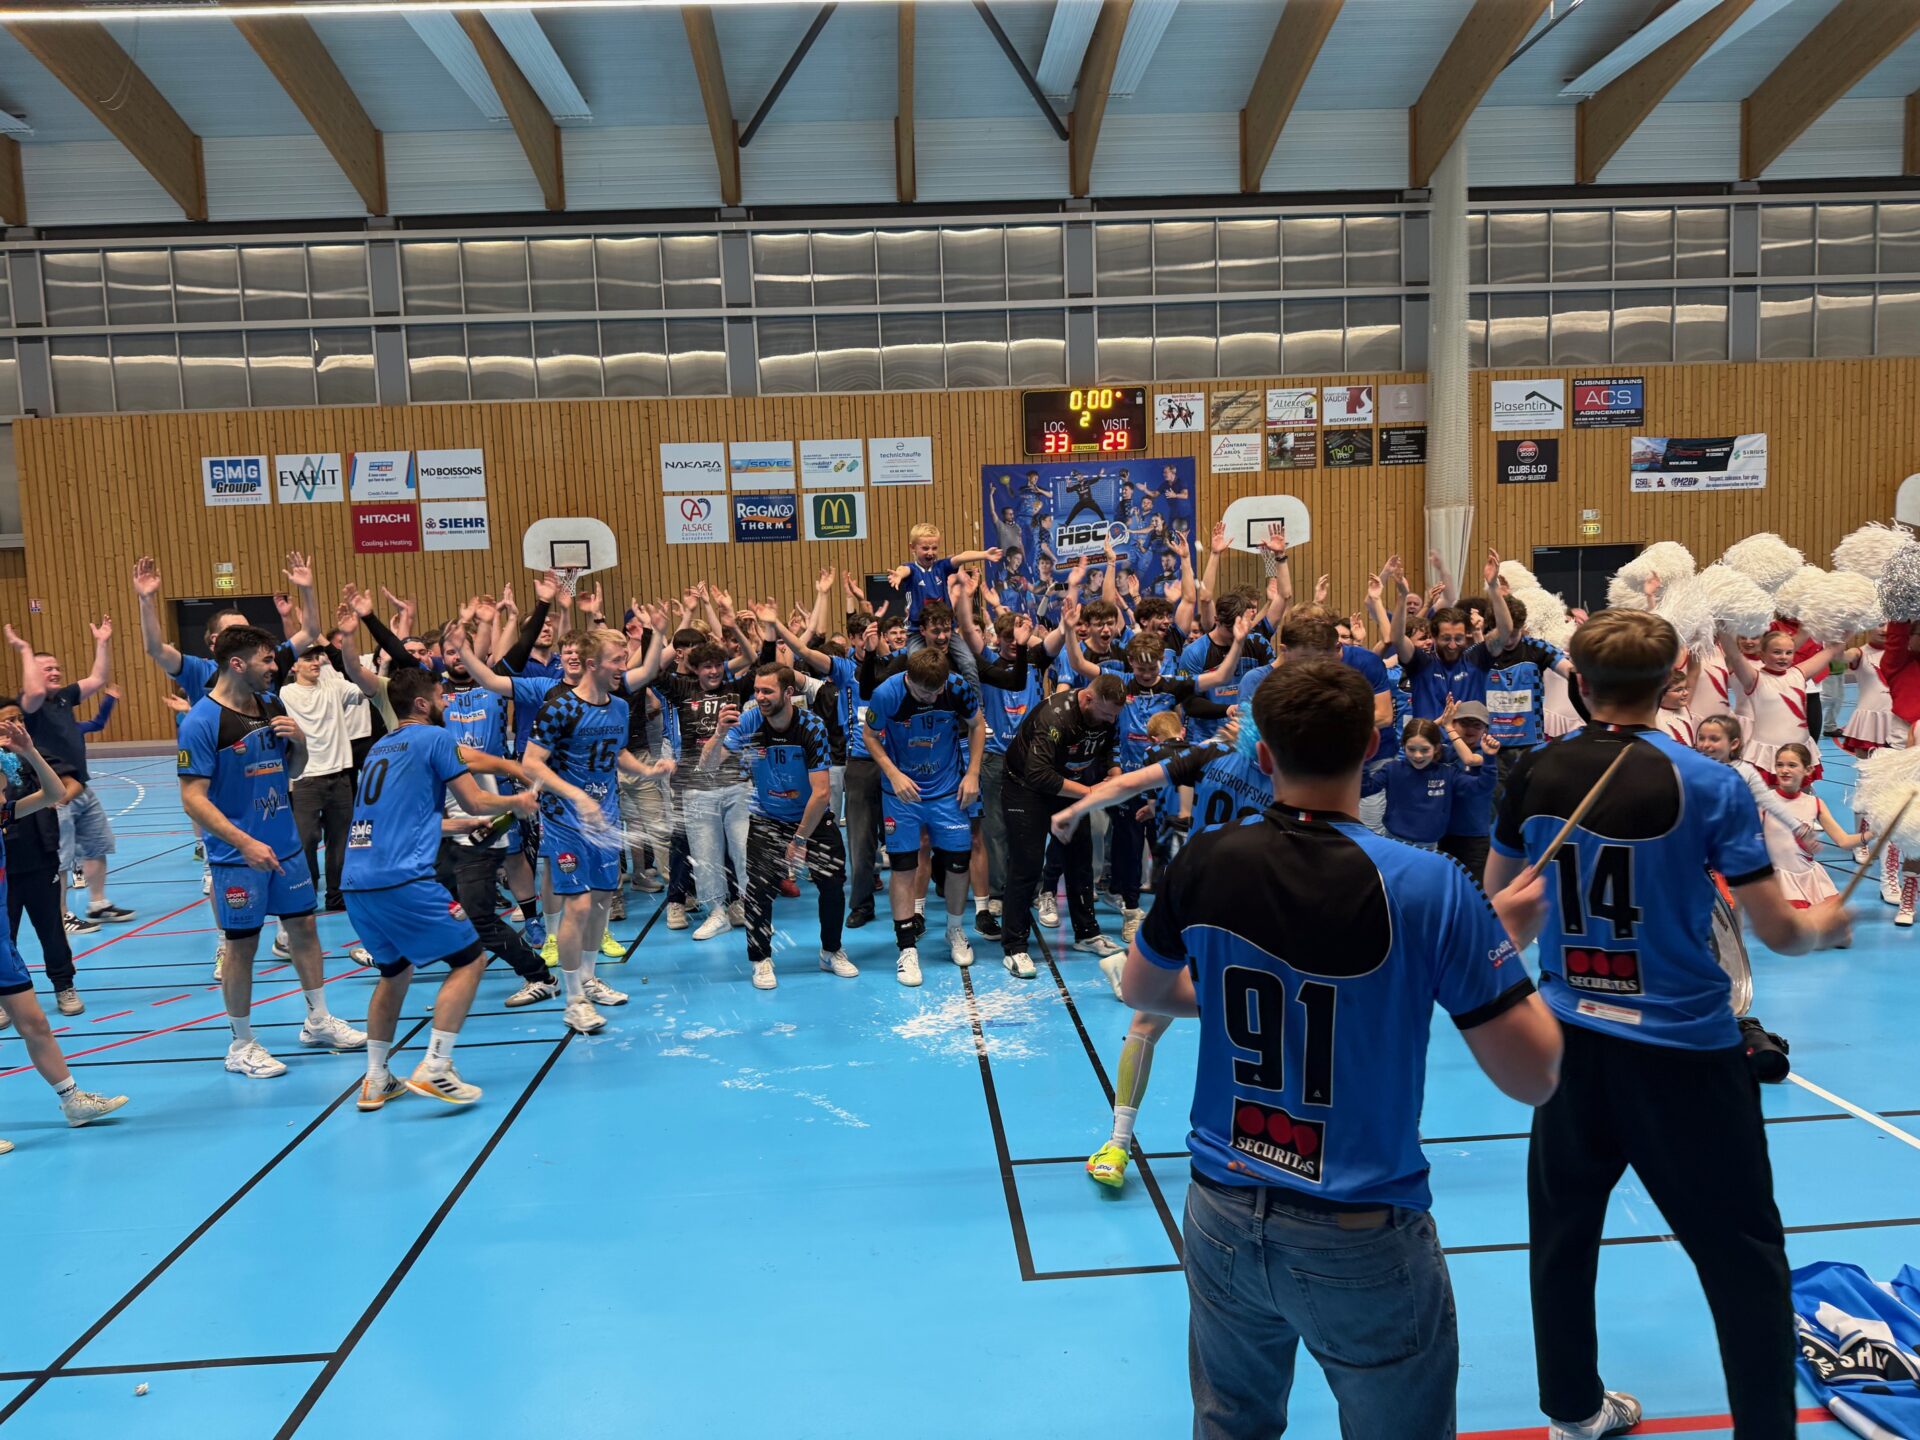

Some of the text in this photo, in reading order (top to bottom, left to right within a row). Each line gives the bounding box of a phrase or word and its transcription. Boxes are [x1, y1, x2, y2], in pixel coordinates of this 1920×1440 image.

[1069, 389, 1113, 410] 0:00
[1584, 390, 1632, 406] ACS
[1494, 401, 1547, 412] Piasentin
[1043, 420, 1069, 433] LOC.
[1079, 410, 1091, 428] 2
[1101, 418, 1131, 431] VISIT.
[1044, 433, 1069, 453] 33
[1102, 431, 1128, 450] 29
[437, 466, 483, 476] BOISSONS
[664, 460, 722, 469] NAKARA
[750, 460, 792, 468] SOVEC
[1507, 464, 1548, 474] CLUBS & CO
[212, 465, 259, 480] SMG
[279, 469, 340, 487] EVALIT
[216, 480, 257, 494] Groupe
[359, 513, 411, 524] HITACHI
[438, 517, 486, 529] SIEHR
[681, 523, 713, 532] ALSACE
[1057, 521, 1108, 547] HBC
[361, 540, 384, 548] Cooling
[390, 539, 413, 547] Heating
[704, 700, 719, 715] 67
[257, 729, 277, 752] 13
[588, 738, 618, 773] 15
[774, 748, 787, 765] 16
[351, 823, 373, 838] SMG
[226, 891, 246, 899] SPORT
[1549, 842, 1644, 940] 14
[1569, 974, 1639, 991] SECURITAS
[1222, 964, 1337, 1107] 91
[1236, 1136, 1315, 1175] SECURITAS
